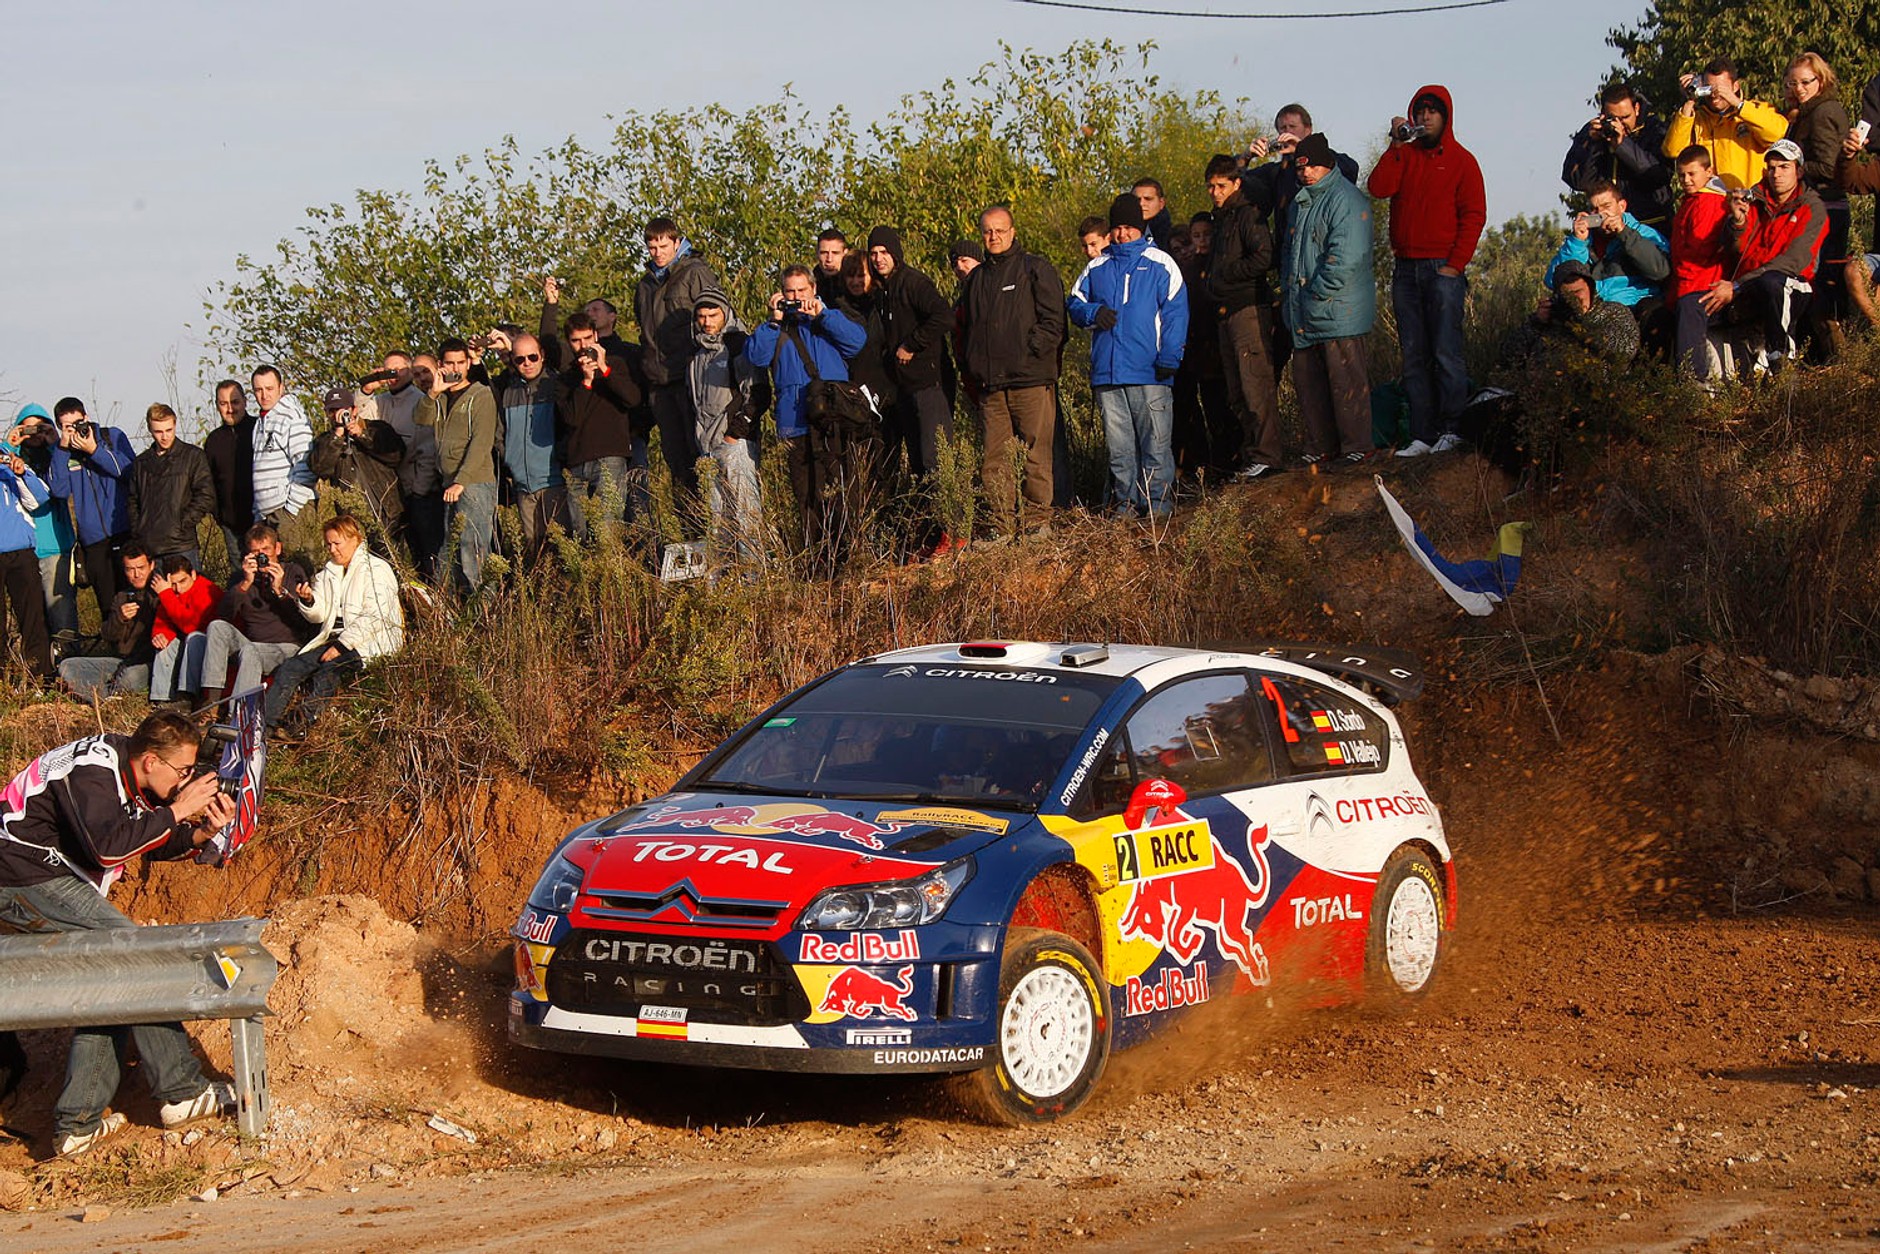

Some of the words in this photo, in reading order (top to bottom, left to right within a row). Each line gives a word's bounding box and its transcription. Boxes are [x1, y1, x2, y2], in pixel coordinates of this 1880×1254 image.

[1060, 727, 1110, 807] CITROEN-WRC.COM
[633, 841, 794, 875] TOTAL
[1117, 836, 1134, 881] 2
[1150, 829, 1199, 869] RACC
[1290, 893, 1363, 930] TOTAL
[800, 932, 860, 962] Red
[861, 929, 921, 961] Bull
[1126, 968, 1168, 1016] Red
[1168, 960, 1209, 1008] Bull
[643, 1007, 682, 1019] AJ-646-MN
[846, 1029, 912, 1045] PIRELLI
[873, 1048, 984, 1064] EURODATACAR
